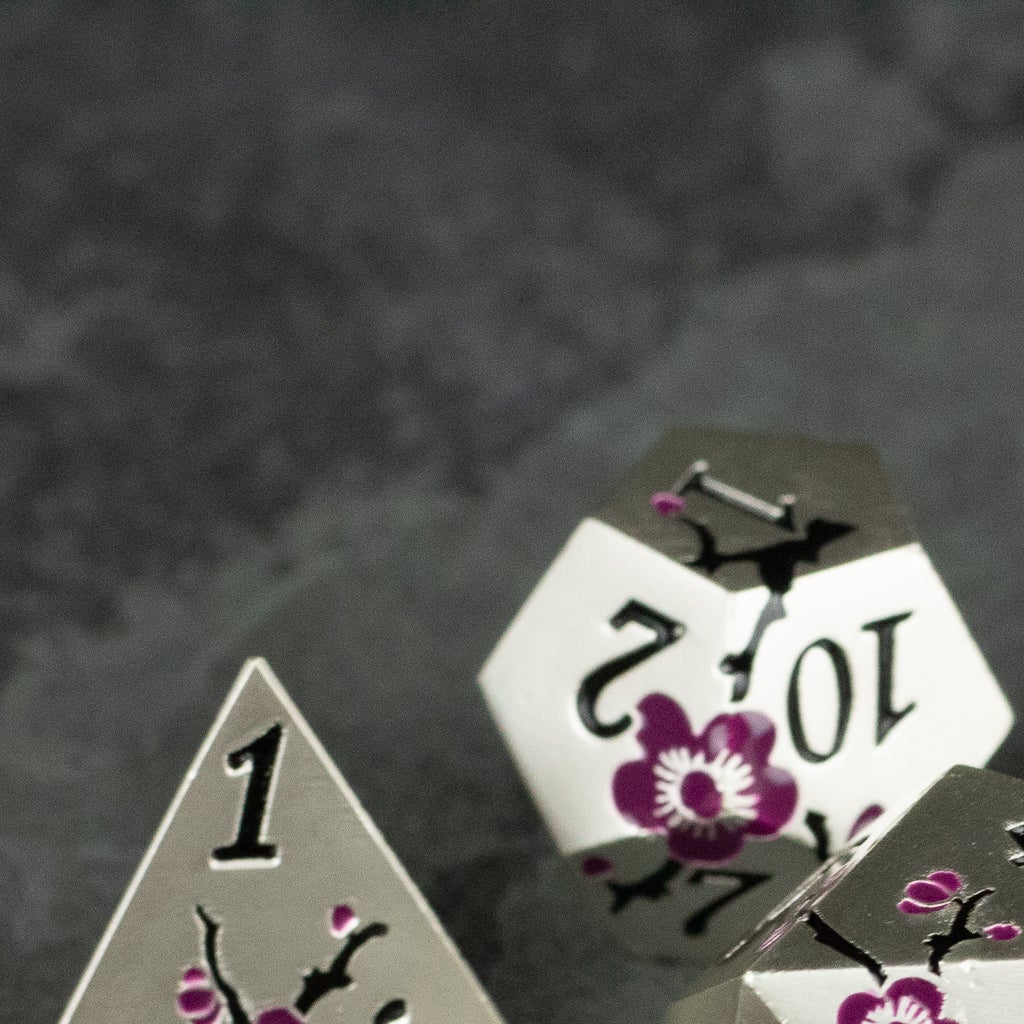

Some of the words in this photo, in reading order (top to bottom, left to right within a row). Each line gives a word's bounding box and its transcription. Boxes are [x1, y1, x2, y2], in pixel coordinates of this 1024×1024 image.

[577, 599, 685, 739] 2
[786, 610, 917, 763] 10
[210, 722, 283, 868] 1
